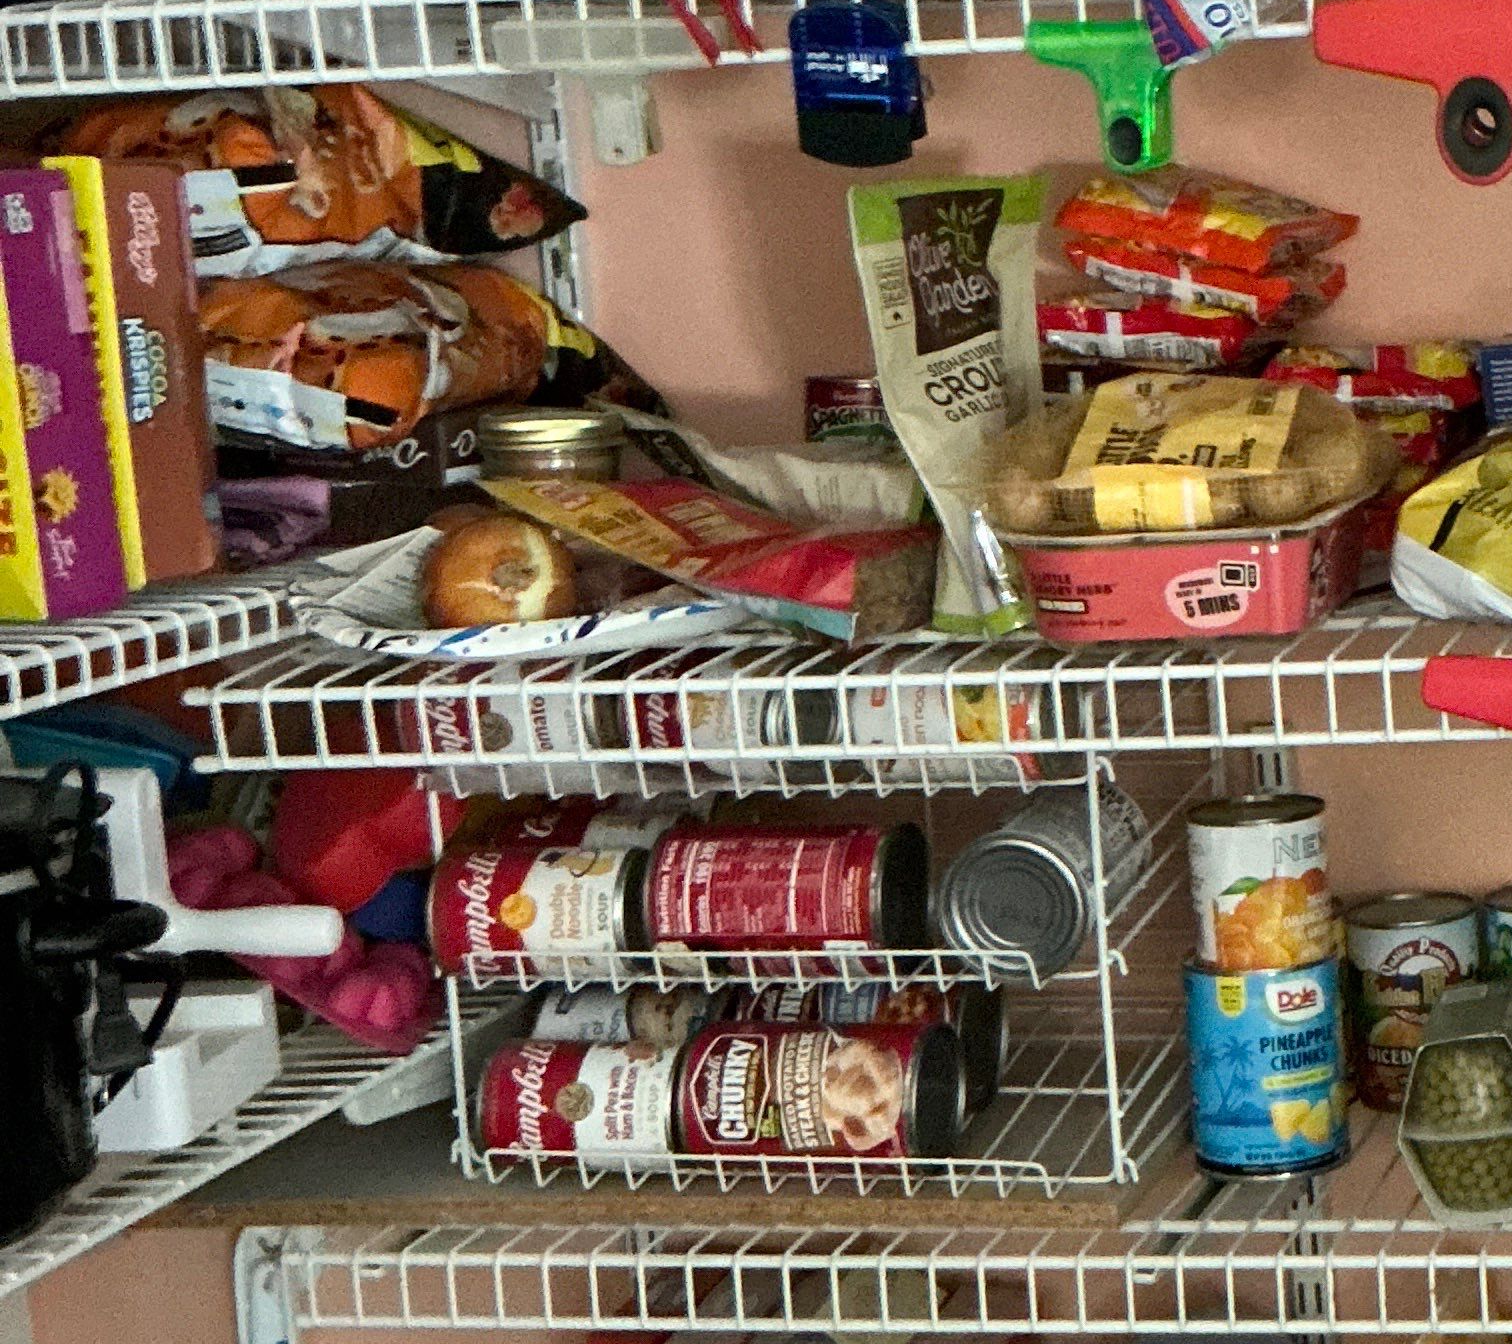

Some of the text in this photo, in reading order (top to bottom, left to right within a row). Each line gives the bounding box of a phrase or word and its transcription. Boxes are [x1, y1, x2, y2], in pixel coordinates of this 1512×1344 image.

[123, 317, 154, 424] KRISPIES
[147, 330, 168, 407] COCOA
[549, 883, 565, 939] Double
[567, 883, 582, 940] Noodle
[598, 891, 609, 931] SOUP
[1277, 987, 1318, 1010] Dole
[1259, 1023, 1333, 1054] PINEAPPLE
[1270, 1046, 1329, 1072] CHUNKS
[718, 1038, 759, 1140] CHUNKY
[604, 1115, 621, 1142] Split
[620, 1113, 634, 1141] Ham
[799, 1098, 819, 1149] STEAK
